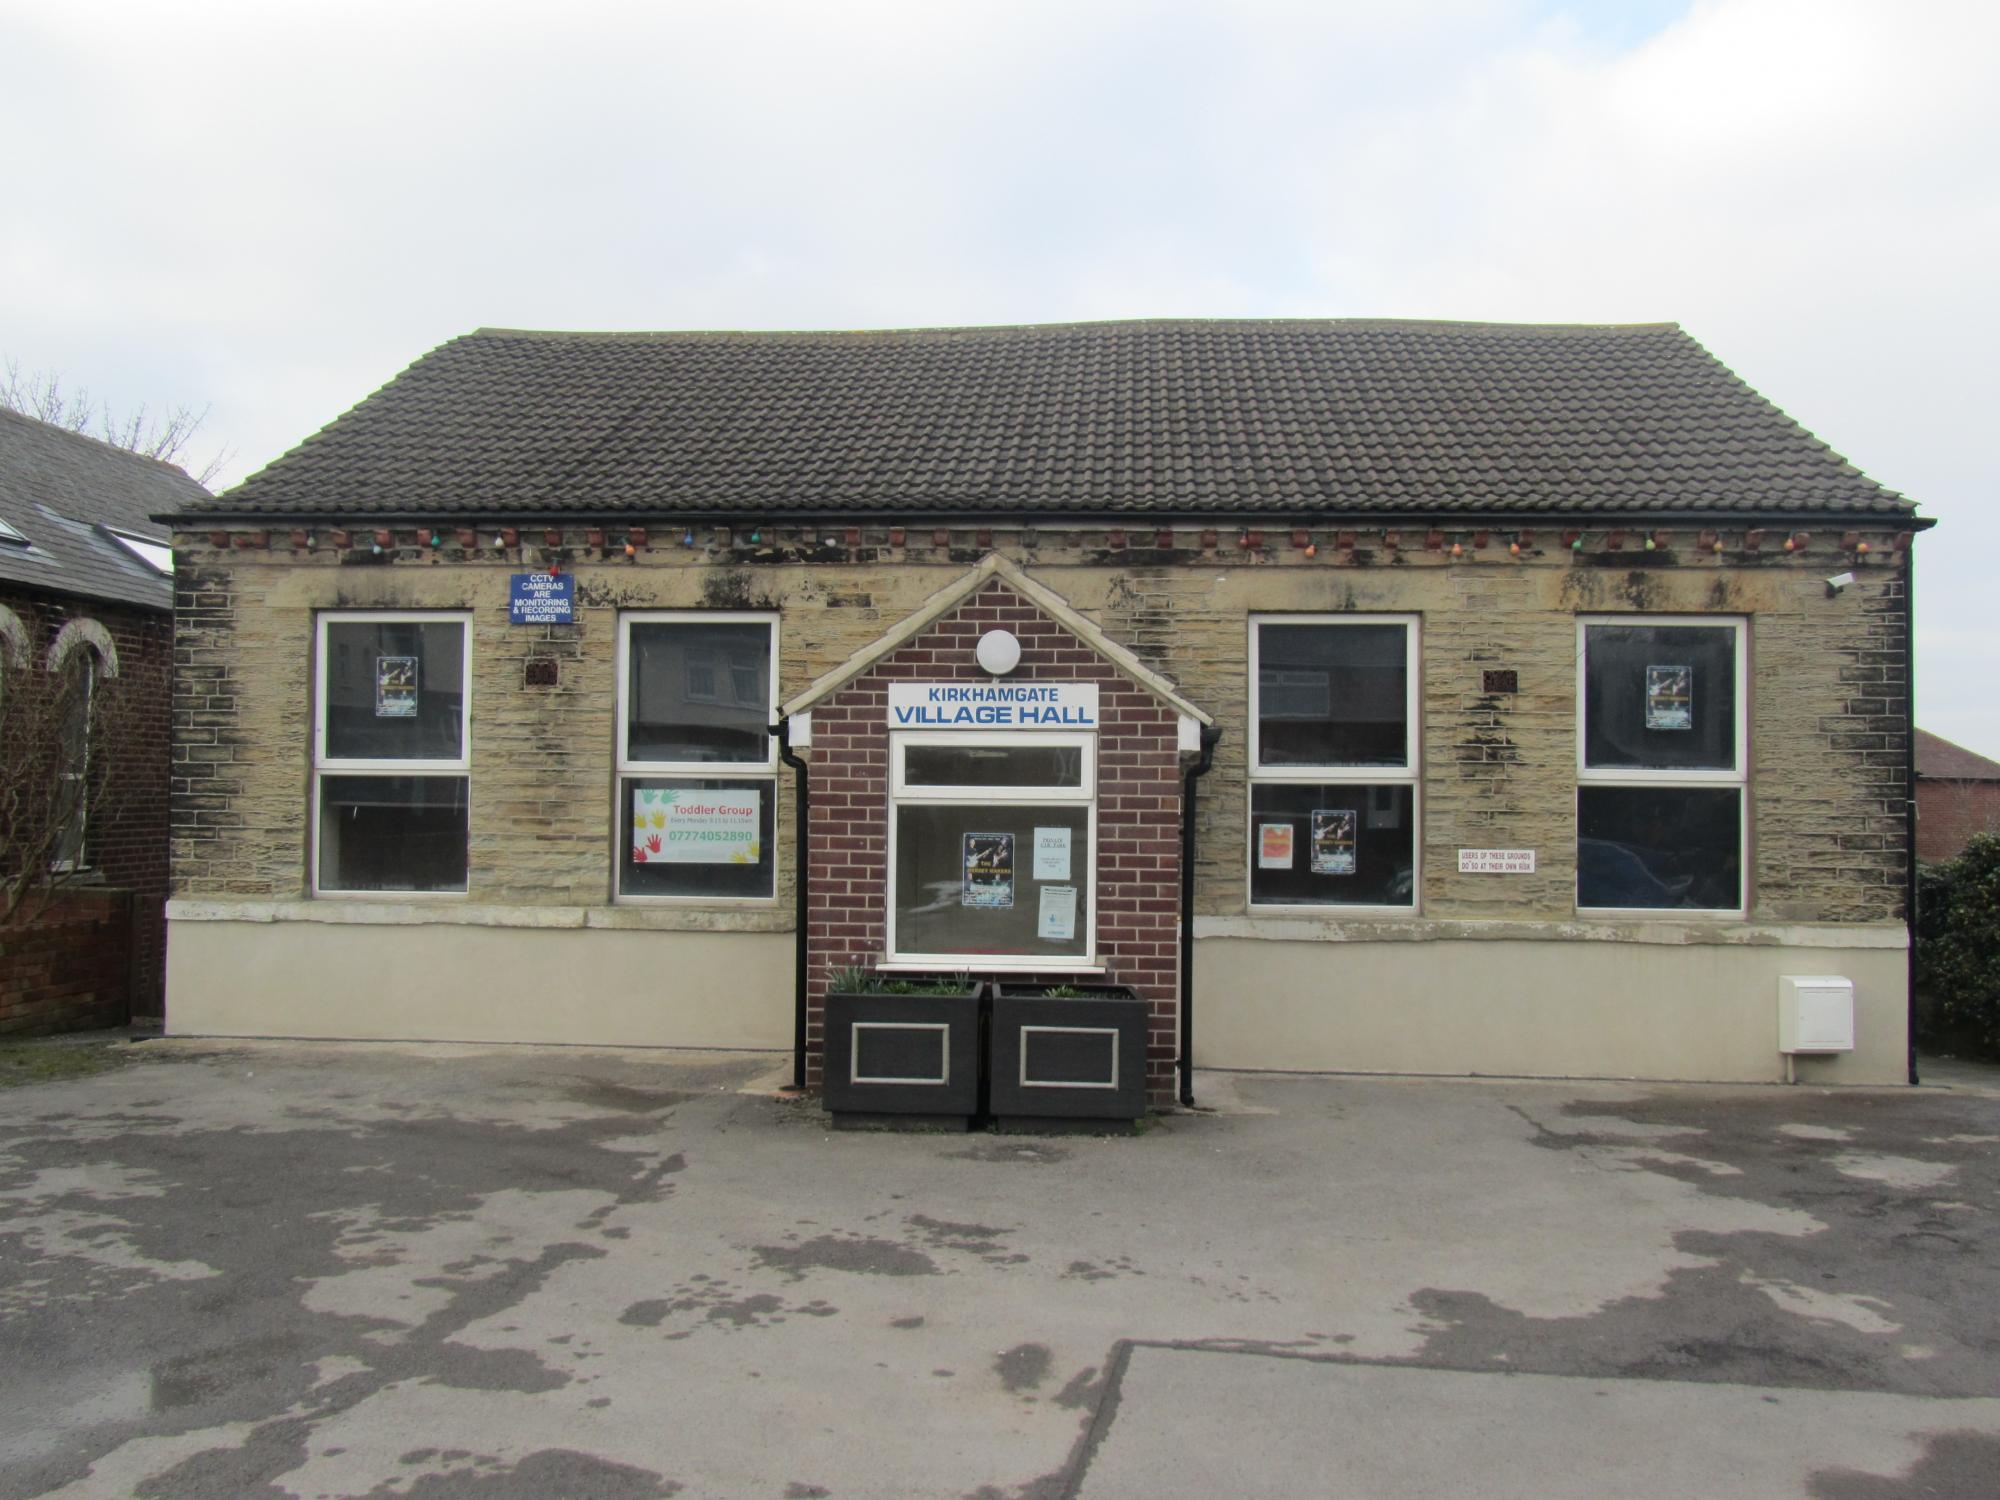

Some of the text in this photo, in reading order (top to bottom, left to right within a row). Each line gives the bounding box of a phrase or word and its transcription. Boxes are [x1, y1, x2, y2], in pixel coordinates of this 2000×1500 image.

[530, 574, 554, 582] CCTV
[522, 582, 564, 590] CAMERAS
[533, 590, 551, 598] ARE
[514, 598, 569, 606] MONITORING
[521, 606, 571, 614] RECORDING
[525, 614, 557, 622] IMAGES
[928, 687, 1059, 702] KIRKHAMGATE
[894, 706, 1094, 724] VILLAGE HALL
[673, 804, 752, 816] Toddler Group
[668, 830, 753, 841] 07774052890
[1461, 851, 1531, 861] USERS OF THESE GROUNDS
[1461, 862, 1470, 870] DO
[1471, 862, 1479, 870] SO
[1480, 862, 1487, 870] AT
[1489, 862, 1504, 870] THEIR
